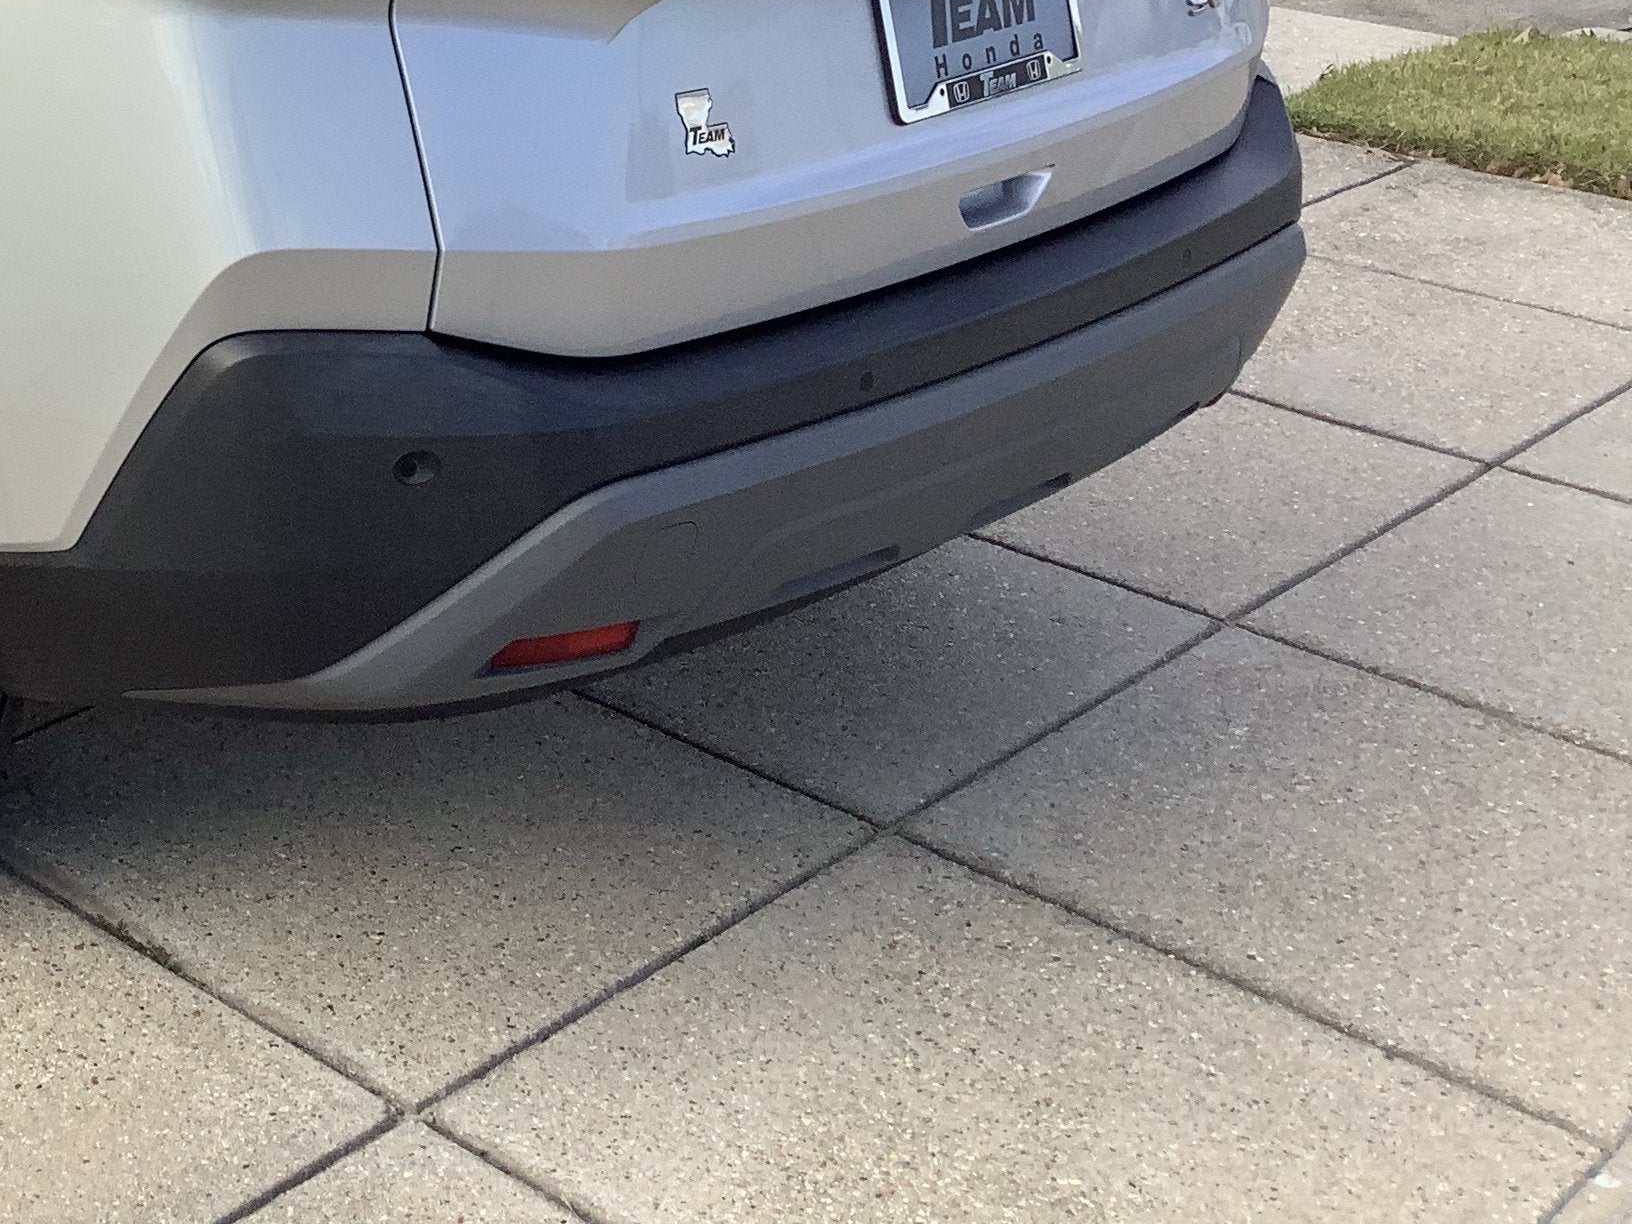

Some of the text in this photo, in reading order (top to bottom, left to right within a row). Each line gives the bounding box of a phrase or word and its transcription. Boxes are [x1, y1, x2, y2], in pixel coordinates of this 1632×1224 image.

[934, 32, 1045, 79] Honda
[979, 70, 1018, 97] TEAM
[689, 125, 726, 146] TEAM
